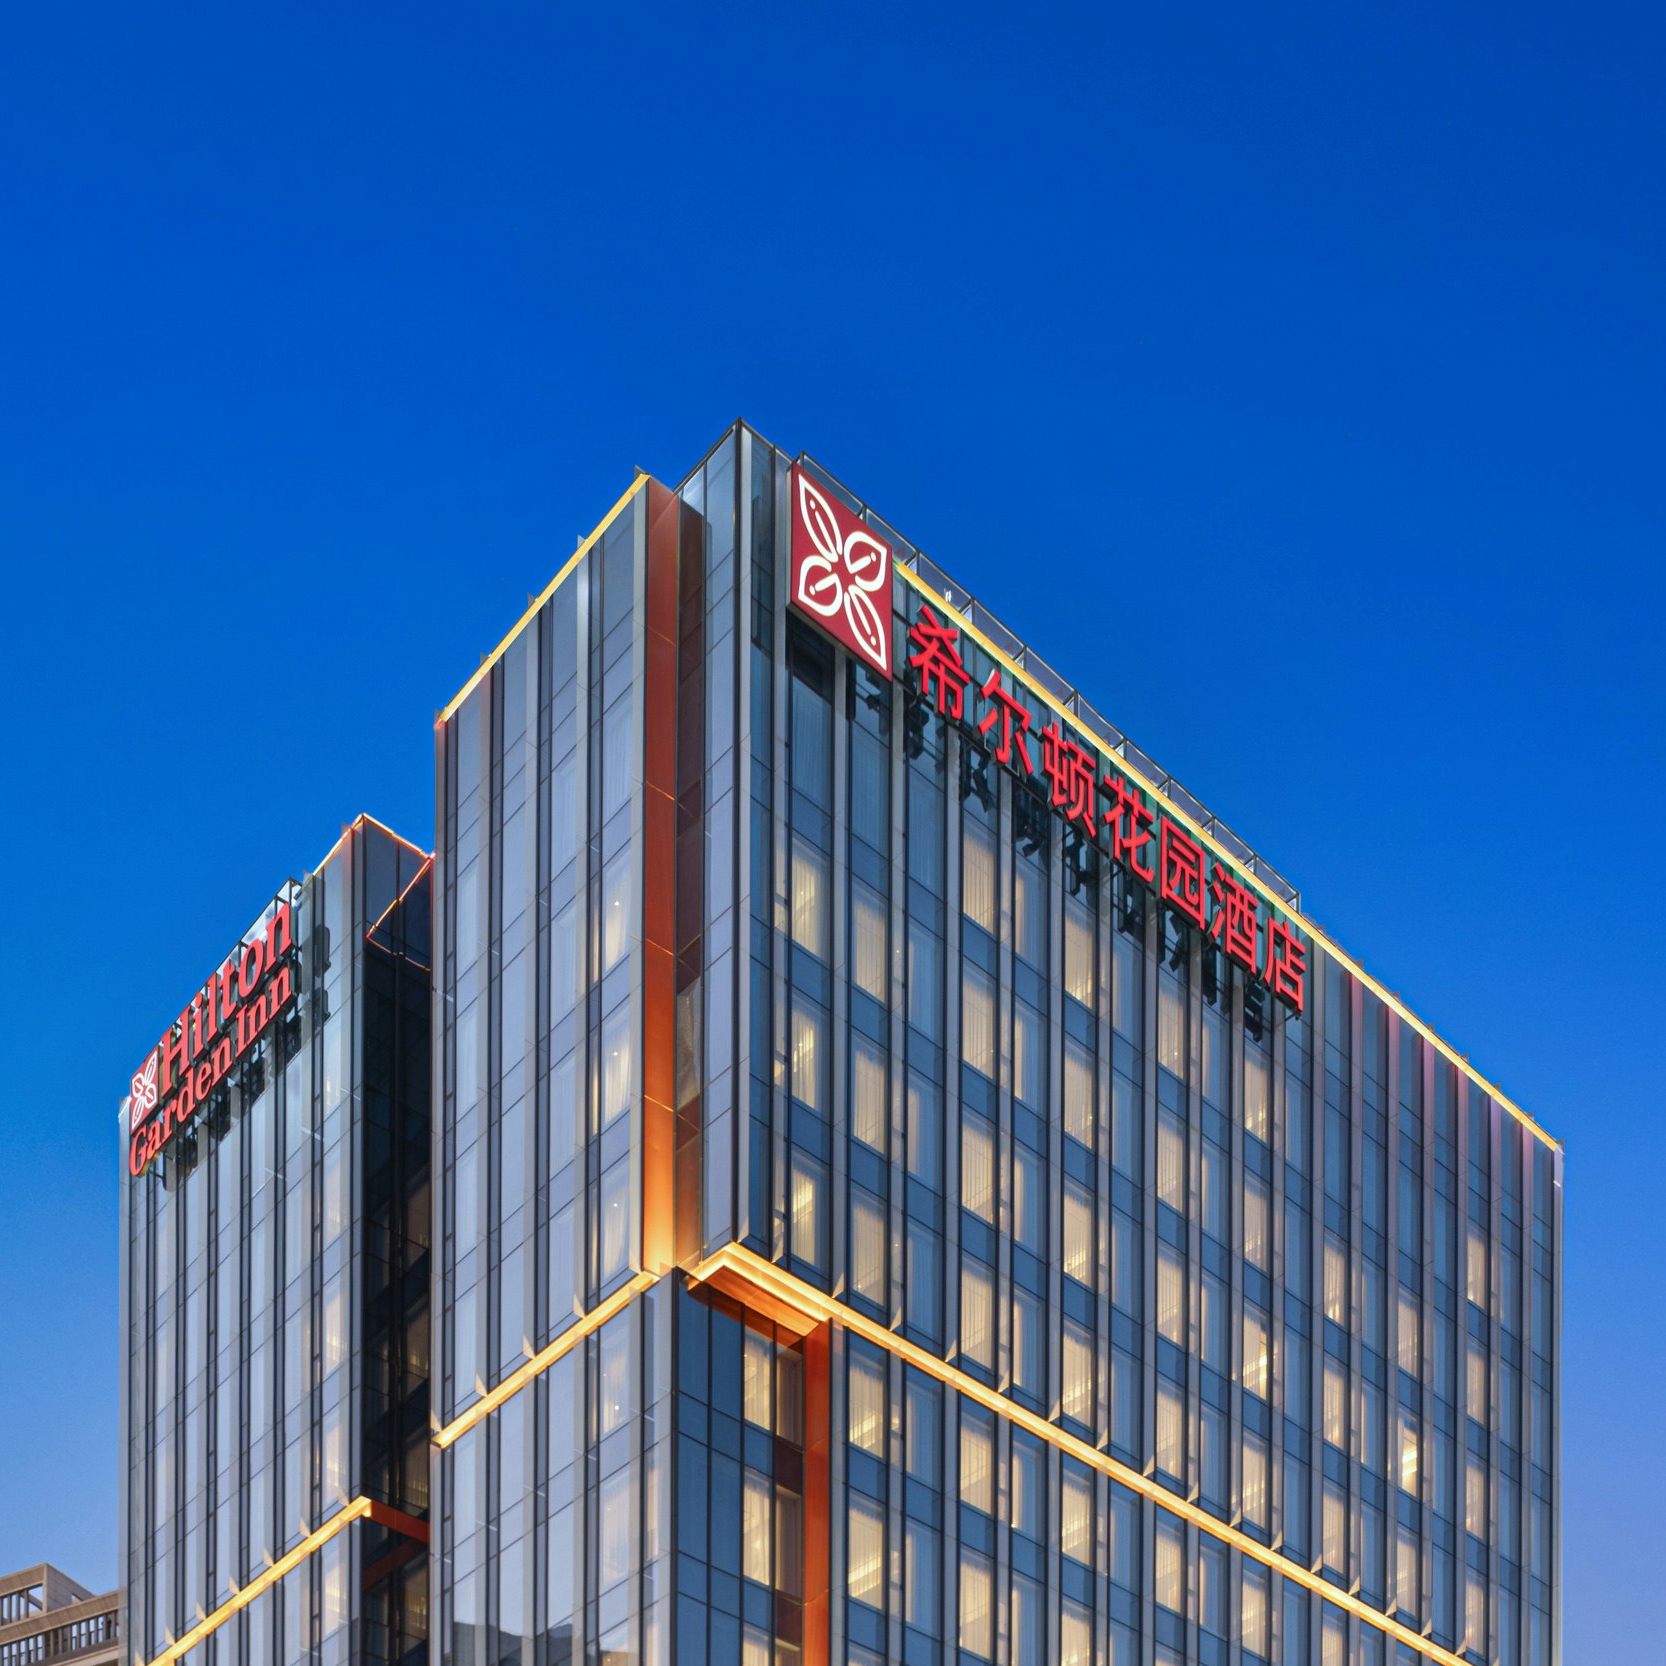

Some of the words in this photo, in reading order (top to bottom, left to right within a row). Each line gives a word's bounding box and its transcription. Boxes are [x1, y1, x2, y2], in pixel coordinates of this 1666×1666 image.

[909, 604, 1306, 1012] 希尔顿花园酒店
[128, 1036, 233, 1178] Garden
[235, 965, 293, 1057] Inn
[159, 901, 293, 1099] Hilton
